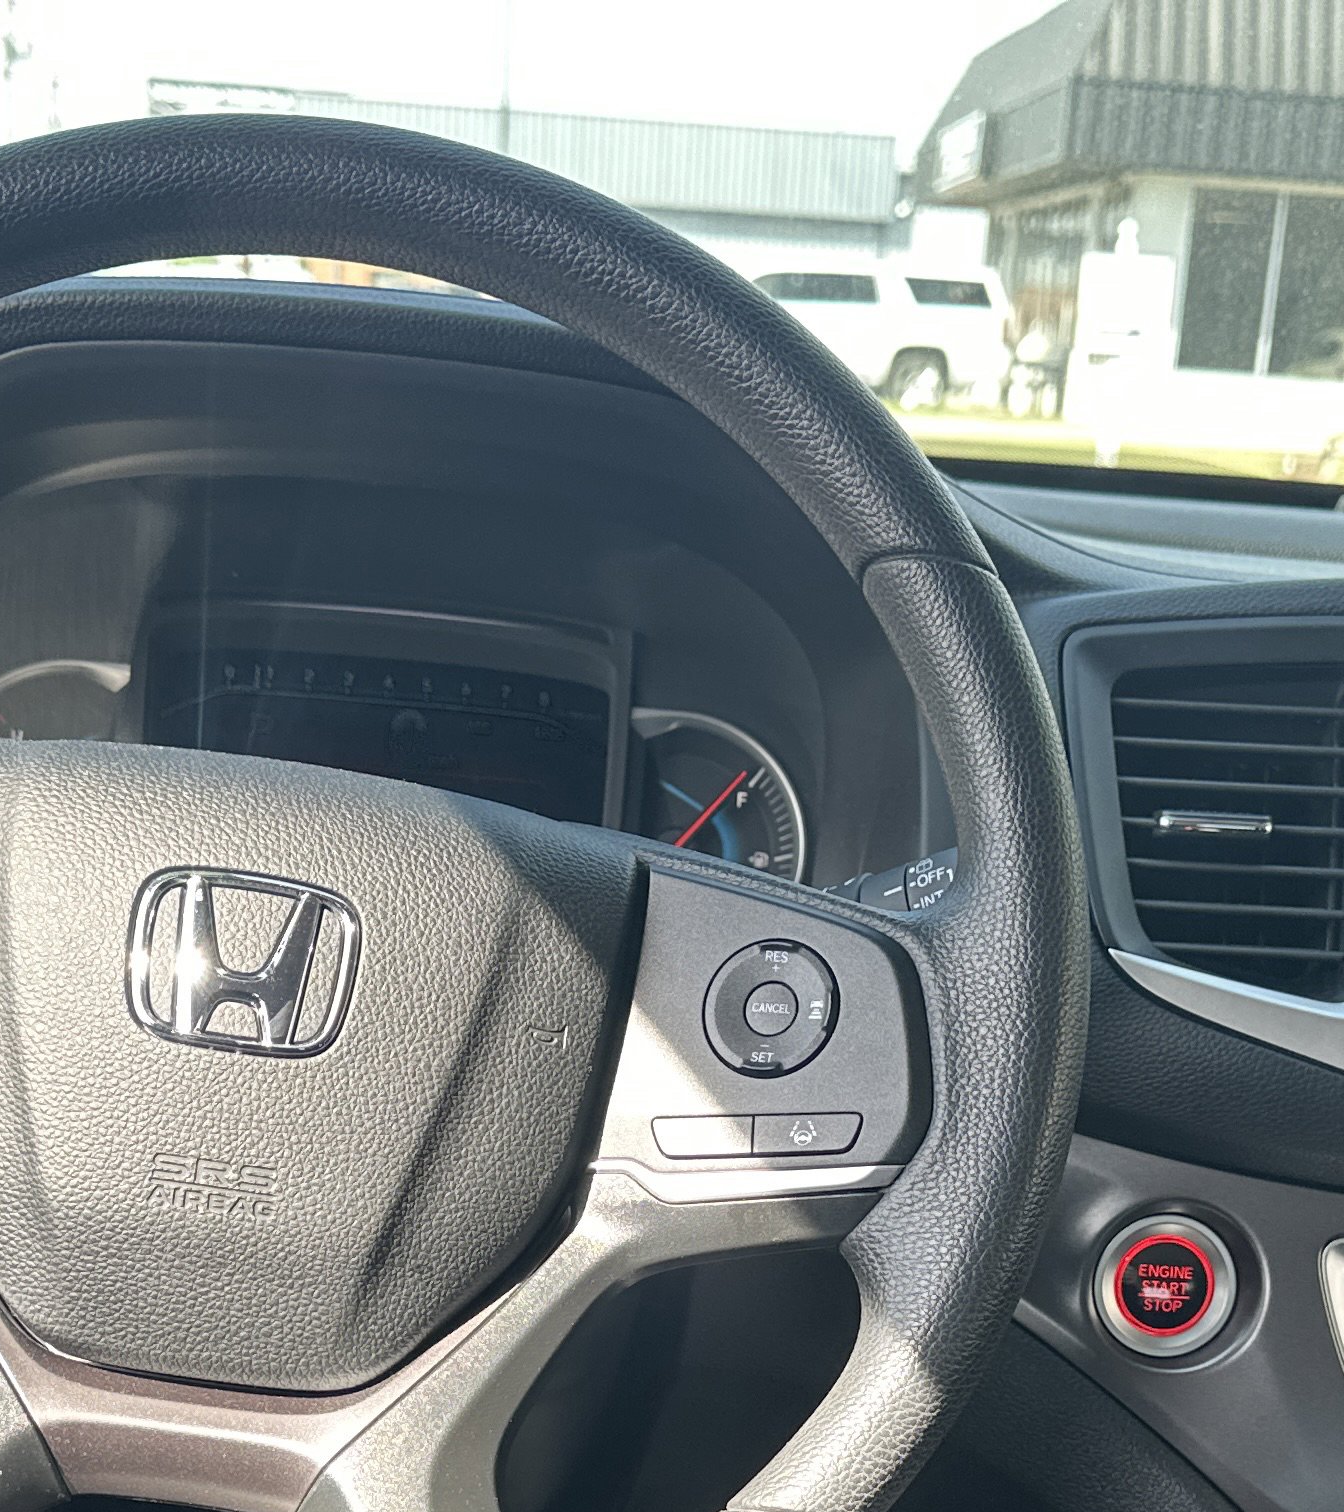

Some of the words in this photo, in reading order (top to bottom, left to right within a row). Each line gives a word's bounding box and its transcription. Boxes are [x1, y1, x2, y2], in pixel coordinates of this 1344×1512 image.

[736, 791, 748, 808] F
[917, 866, 946, 888] OFF
[919, 889, 944, 909] INT
[764, 950, 789, 964] RES
[751, 1002, 791, 1015] CANCEL
[750, 1051, 774, 1064] SET
[150, 1152, 277, 1191] SRS
[1138, 1263, 1194, 1280] ENGINE
[1141, 1279, 1190, 1296] START
[1143, 1299, 1183, 1313] STOP
